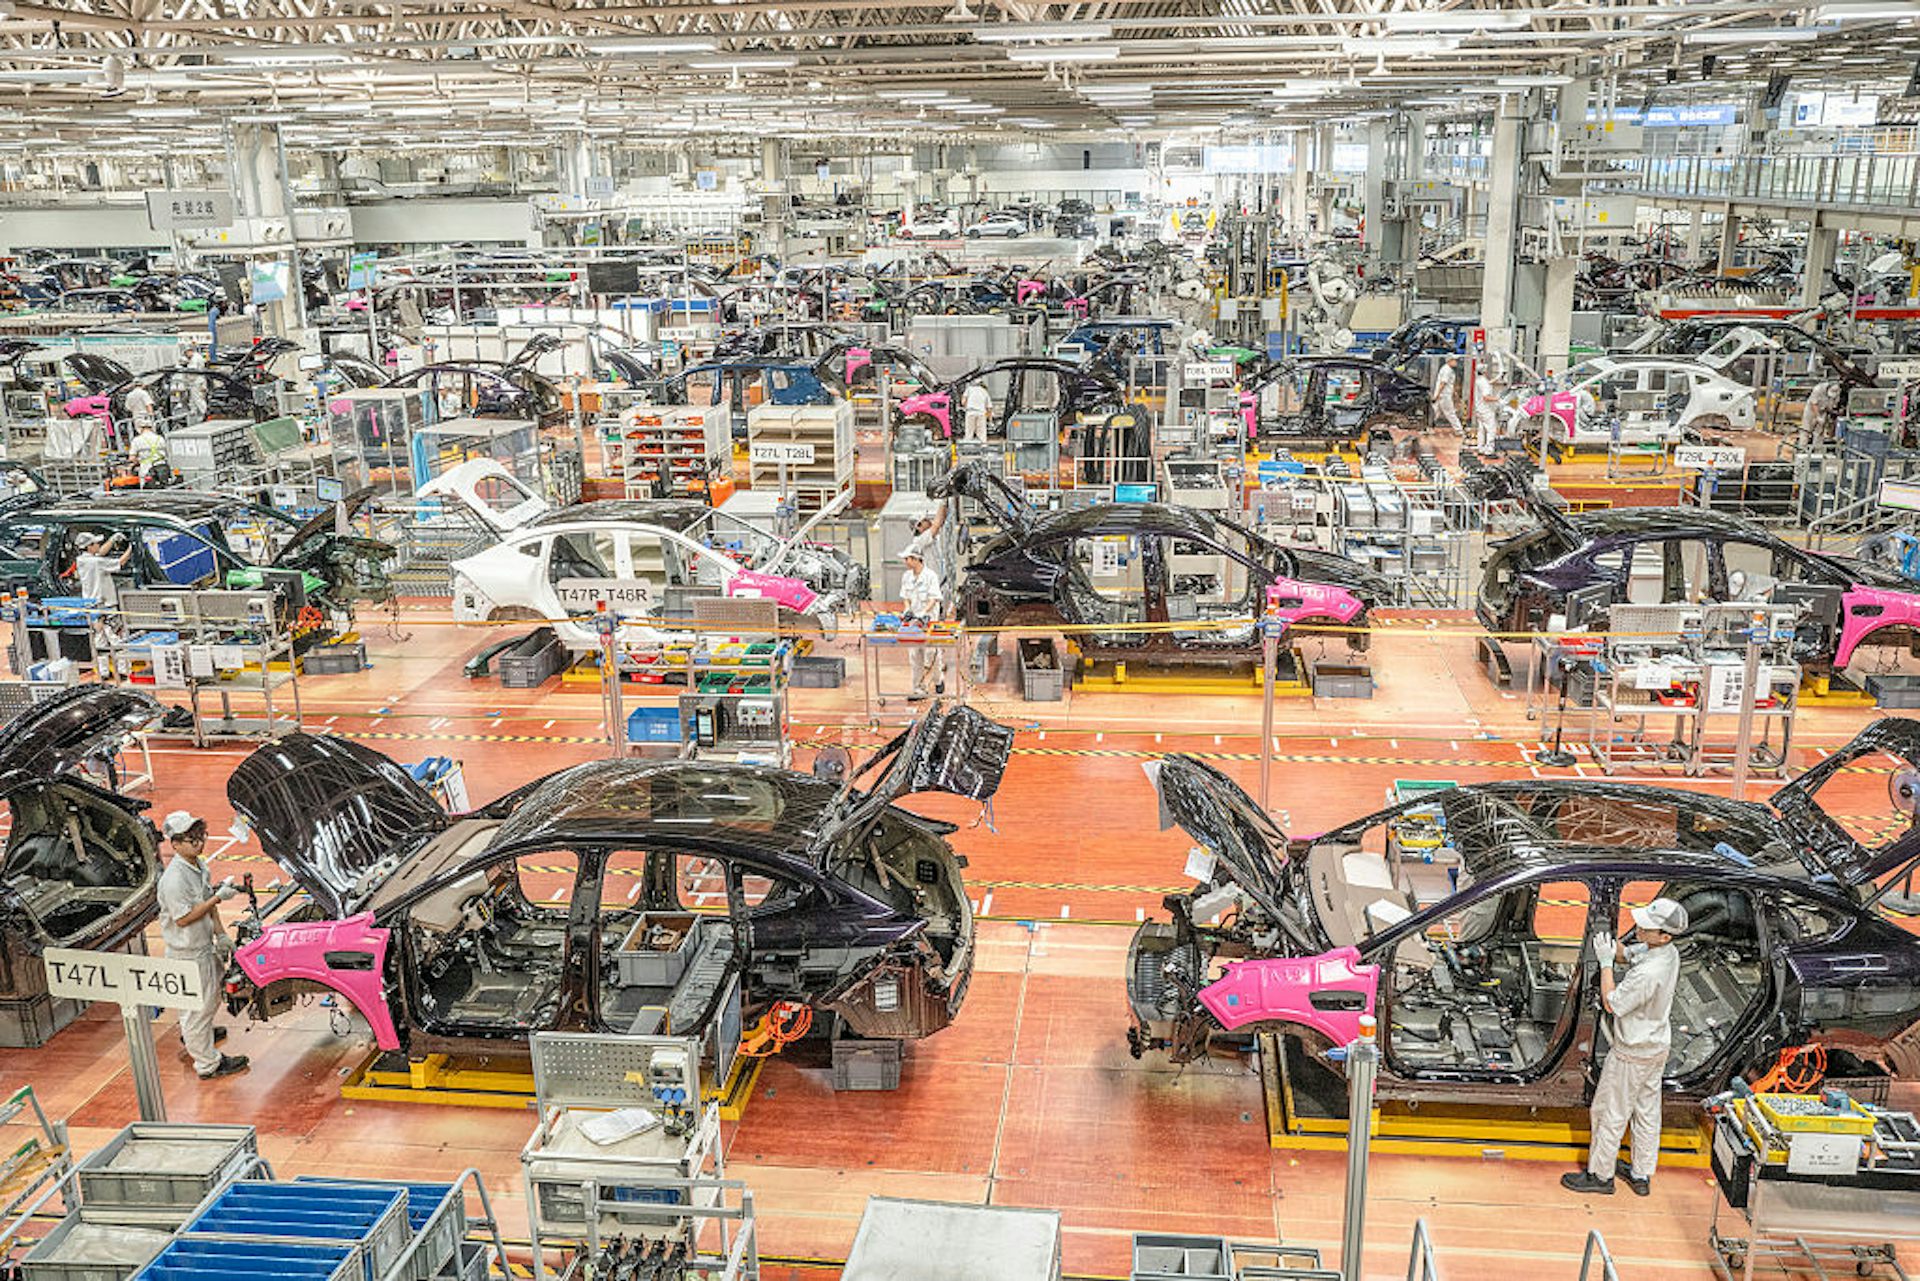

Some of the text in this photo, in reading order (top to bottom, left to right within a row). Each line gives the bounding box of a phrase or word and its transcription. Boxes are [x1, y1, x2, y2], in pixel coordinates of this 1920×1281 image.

[754, 448, 812, 458] T27L T28L
[559, 588, 647, 602] T47R T46R
[49, 962, 198, 997] T47L T46L
